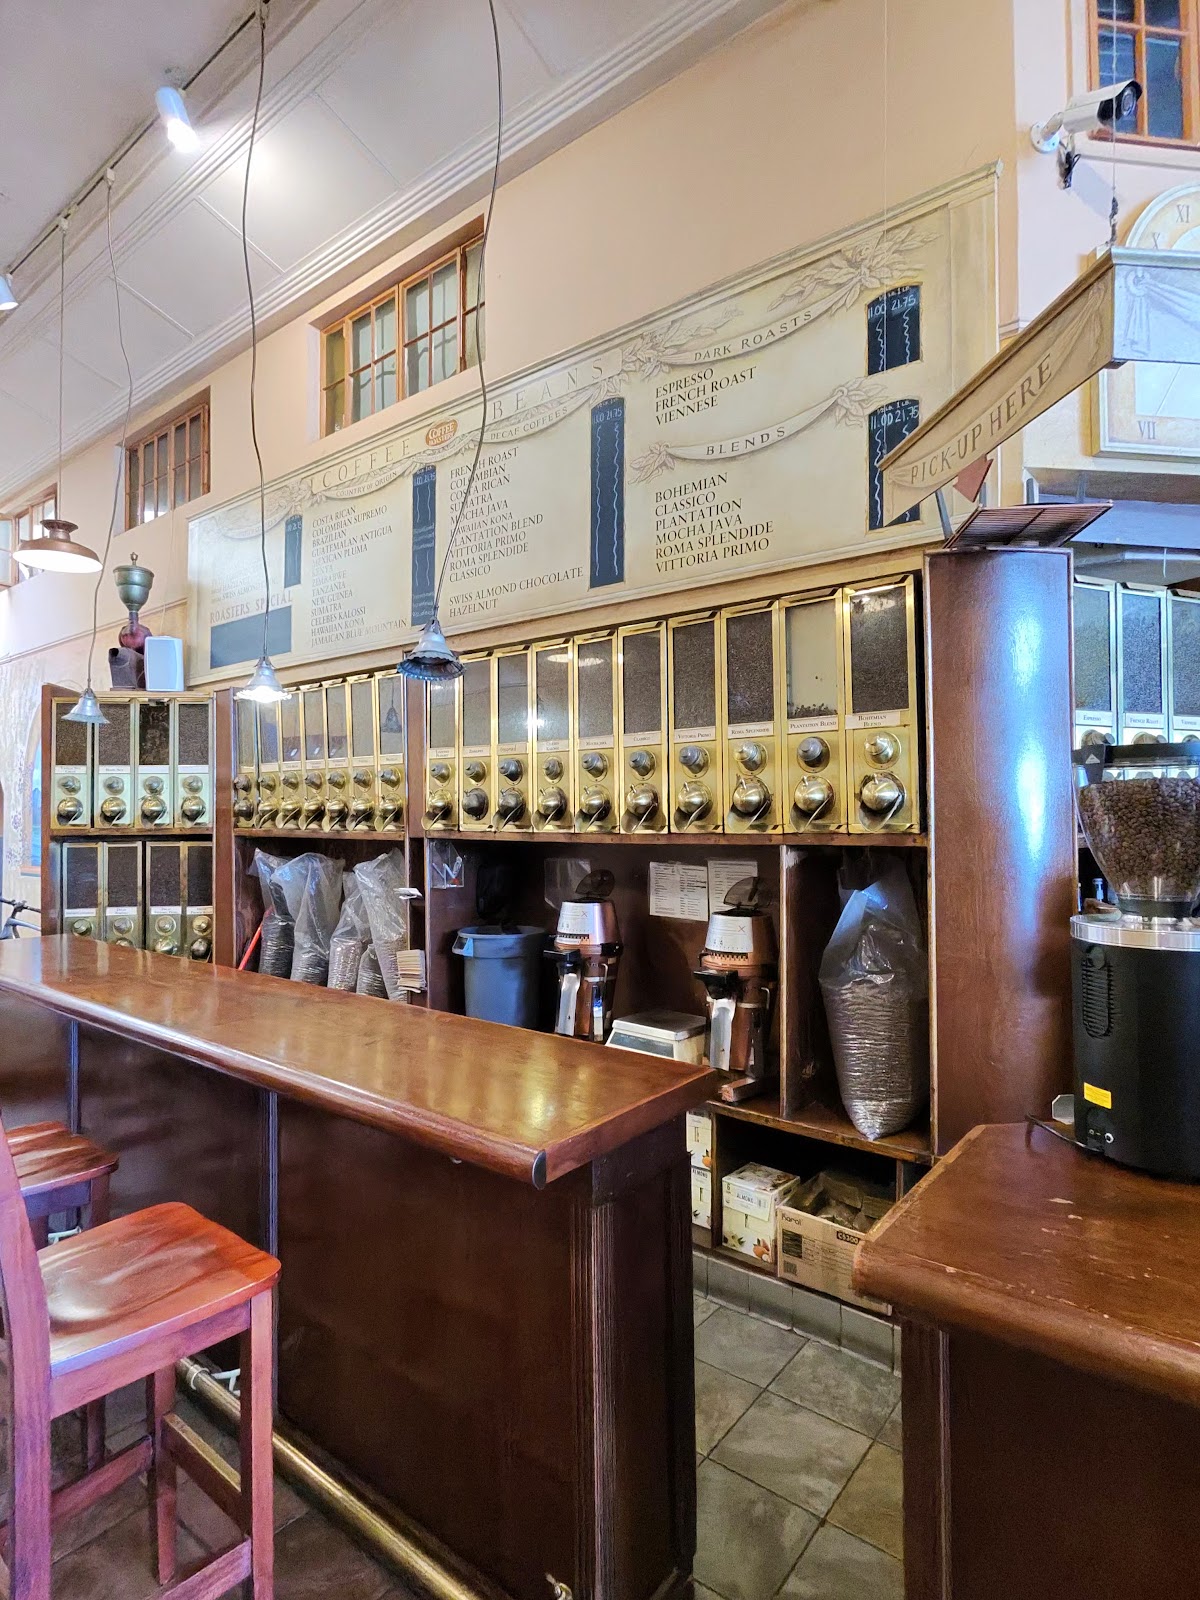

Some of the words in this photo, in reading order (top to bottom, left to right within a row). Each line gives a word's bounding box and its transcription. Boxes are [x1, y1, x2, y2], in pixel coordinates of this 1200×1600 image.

[891, 294, 917, 311] 21.75
[694, 344, 732, 361] DARK
[740, 311, 813, 350] ROASTS
[493, 364, 603, 420] BEANS
[655, 368, 714, 398] ESPRESSO
[655, 384, 706, 413] FRENCH
[710, 366, 757, 393] ROAST
[490, 427, 520, 440] DECAF
[523, 407, 568, 432] COFFEES
[655, 396, 718, 426] VIENNESE
[895, 405, 919, 422] 21.75
[910, 425, 982, 484] PICK-UP
[989, 353, 1052, 437] HERE
[705, 426, 785, 456] BLENDS
[323, 438, 410, 488] COFFEE
[450, 460, 486, 479] FRENH
[488, 447, 519, 466] ROAST
[336, 486, 365, 498] COUNTRY
[375, 471, 397, 487] ORIGIN
[481, 474, 510, 494] RICAN
[655, 473, 728, 503] BOHEMIAN
[312, 515, 334, 529] COSTA
[334, 505, 356, 520] RICAN
[486, 500, 508, 516] JAVA
[490, 512, 513, 525] KONA
[655, 491, 716, 517] CLASSICO
[655, 499, 743, 531] PLANTATION
[312, 518, 353, 538] COLOMBIAN
[353, 505, 388, 524] SUPREMO
[450, 524, 508, 547] LANTATION
[511, 513, 543, 531] BLEND
[655, 524, 706, 546] MOCHA
[707, 514, 743, 536] JAVA
[312, 529, 347, 547] BRAZILIAN
[312, 535, 358, 558] GUATEMALAN
[359, 525, 393, 542] ANTIGUA
[344, 544, 368, 557] PLUMA
[495, 531, 526, 547] PRIMO
[655, 541, 694, 560] ROMA
[697, 520, 774, 551] SPLENDIDE
[450, 556, 477, 571] ROMA
[478, 542, 529, 563] SPLENDIDE
[656, 551, 718, 574] VITTORIA
[723, 537, 770, 559] PRIMO
[449, 592, 473, 606] SWISS
[475, 583, 517, 600] ALMOND
[519, 567, 584, 590] CHOCOLATE
[450, 564, 491, 583] CLASSICO
[311, 596, 327, 608] NEW
[328, 589, 353, 603] GUINEA
[312, 581, 346, 597] TANZANIA
[210, 602, 250, 624] ROASTERS
[255, 591, 293, 612] SPCIAL
[311, 602, 342, 617] SUMATRA
[311, 614, 338, 627] CELEBES
[338, 606, 366, 620] KALOSSI
[450, 599, 498, 618] HAZELNUT
[311, 624, 344, 637] HAWAIIAN
[344, 618, 365, 629] KONA
[311, 633, 345, 648] JAMAICAN
[346, 629, 363, 638] BLUE
[365, 618, 408, 635] MOUNTAIN
